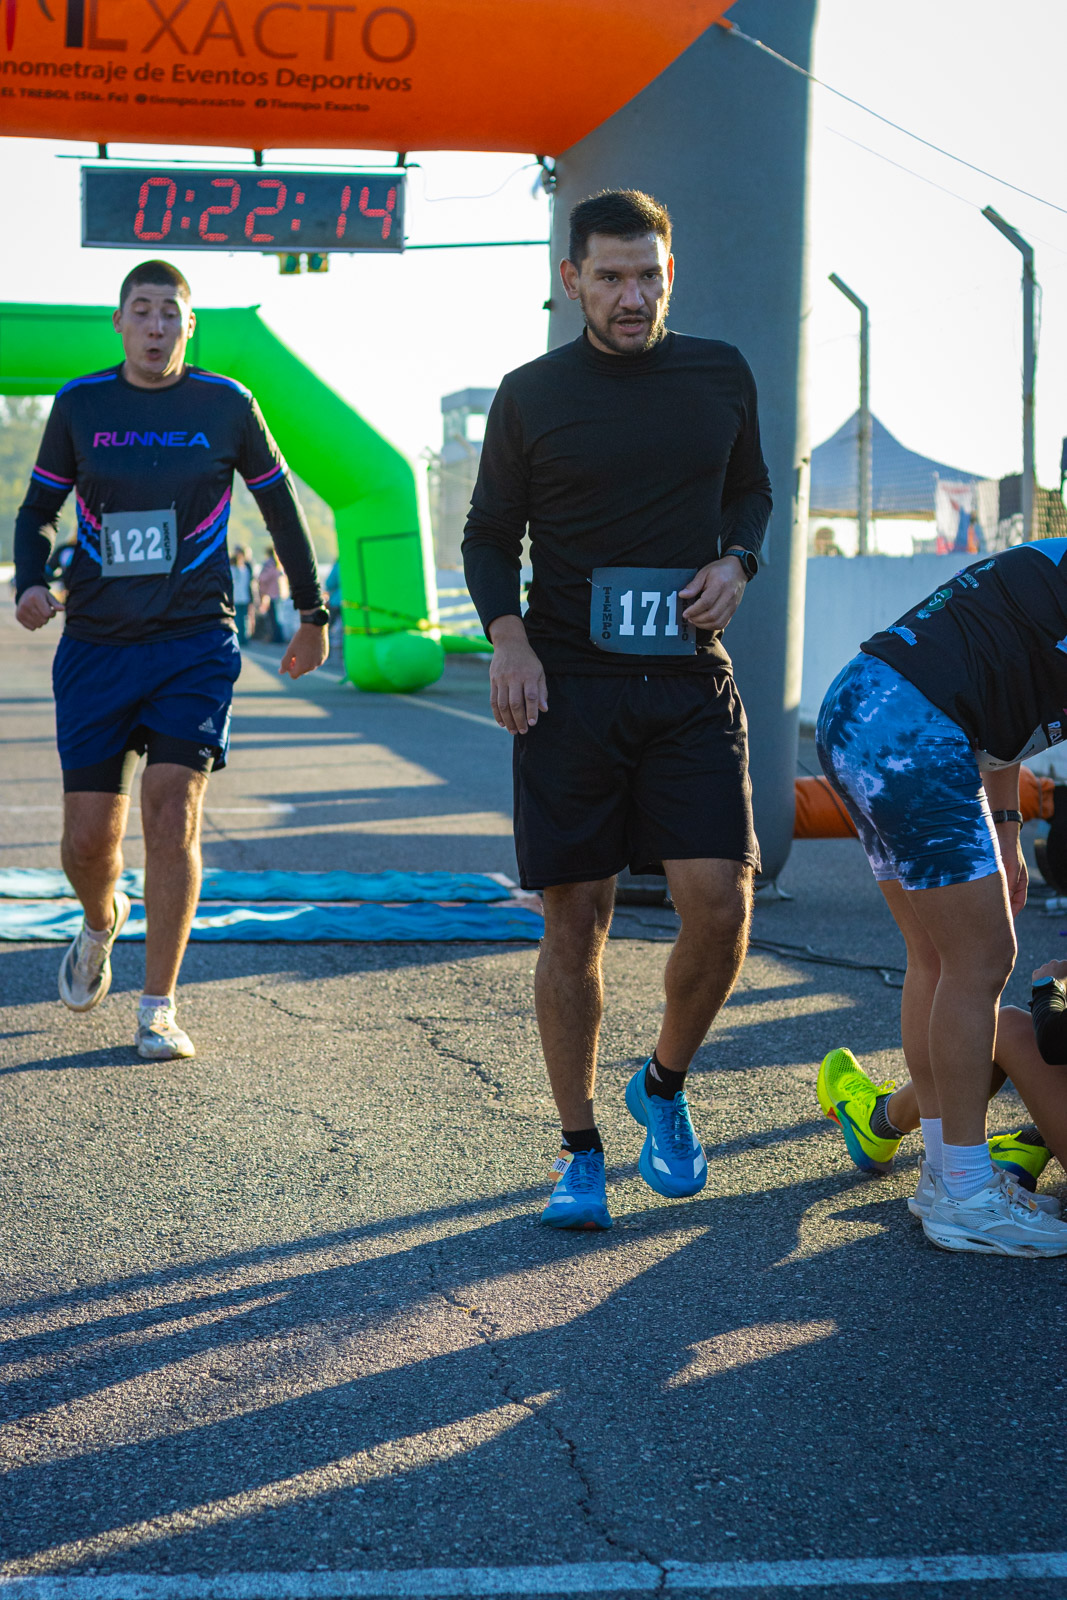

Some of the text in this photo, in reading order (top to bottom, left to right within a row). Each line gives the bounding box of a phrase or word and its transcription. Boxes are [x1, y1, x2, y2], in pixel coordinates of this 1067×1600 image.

[0, 60, 412, 92] nometraje de Eventos Deportivos
[93, 431, 210, 448] RUNNEA
[111, 526, 163, 563] 122
[163, 522, 171, 561] EXACTO
[602, 586, 612, 640] TIEMPO
[619, 590, 679, 636] 171
